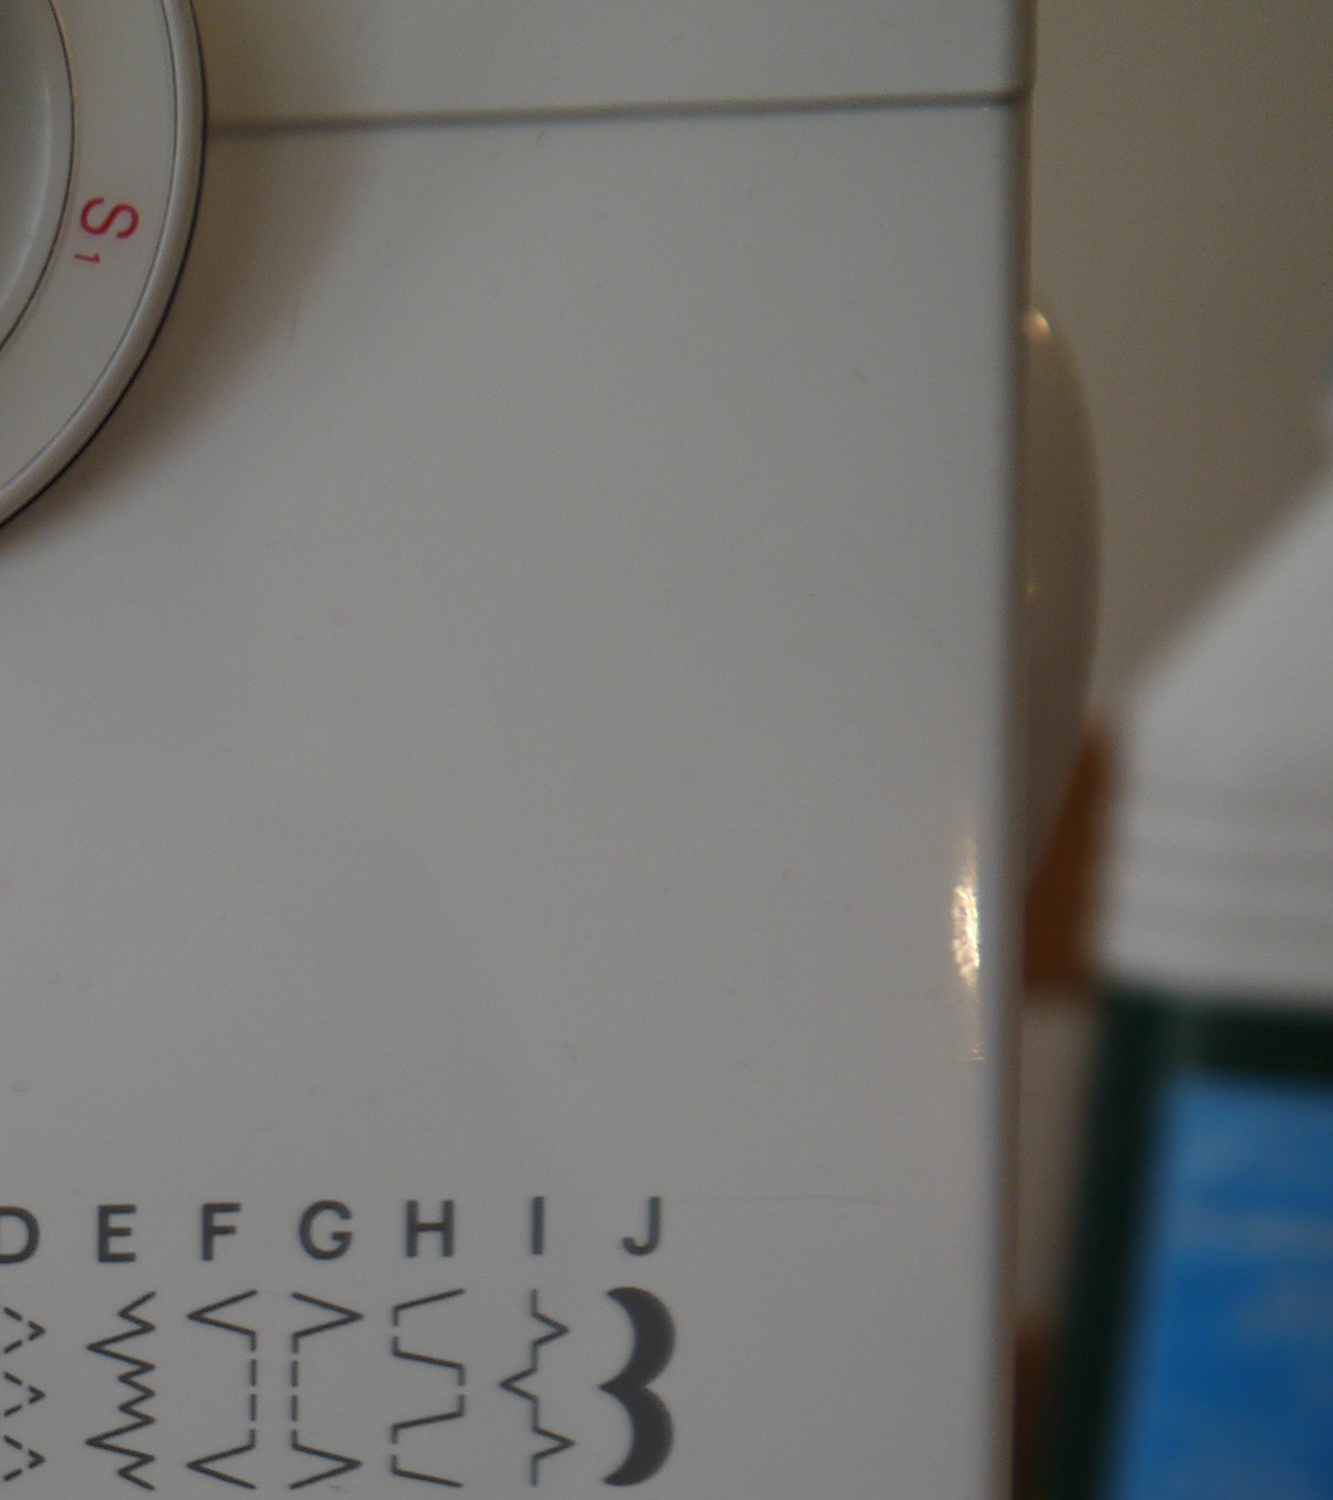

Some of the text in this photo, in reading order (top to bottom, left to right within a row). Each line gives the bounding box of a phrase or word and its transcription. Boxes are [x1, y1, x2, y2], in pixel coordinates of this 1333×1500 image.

[96, 1203, 138, 1264] E
[200, 1202, 242, 1262] F
[297, 1199, 354, 1262] G
[405, 1199, 455, 1259] H
[530, 1195, 546, 1257] I
[621, 1195, 662, 1257] J
